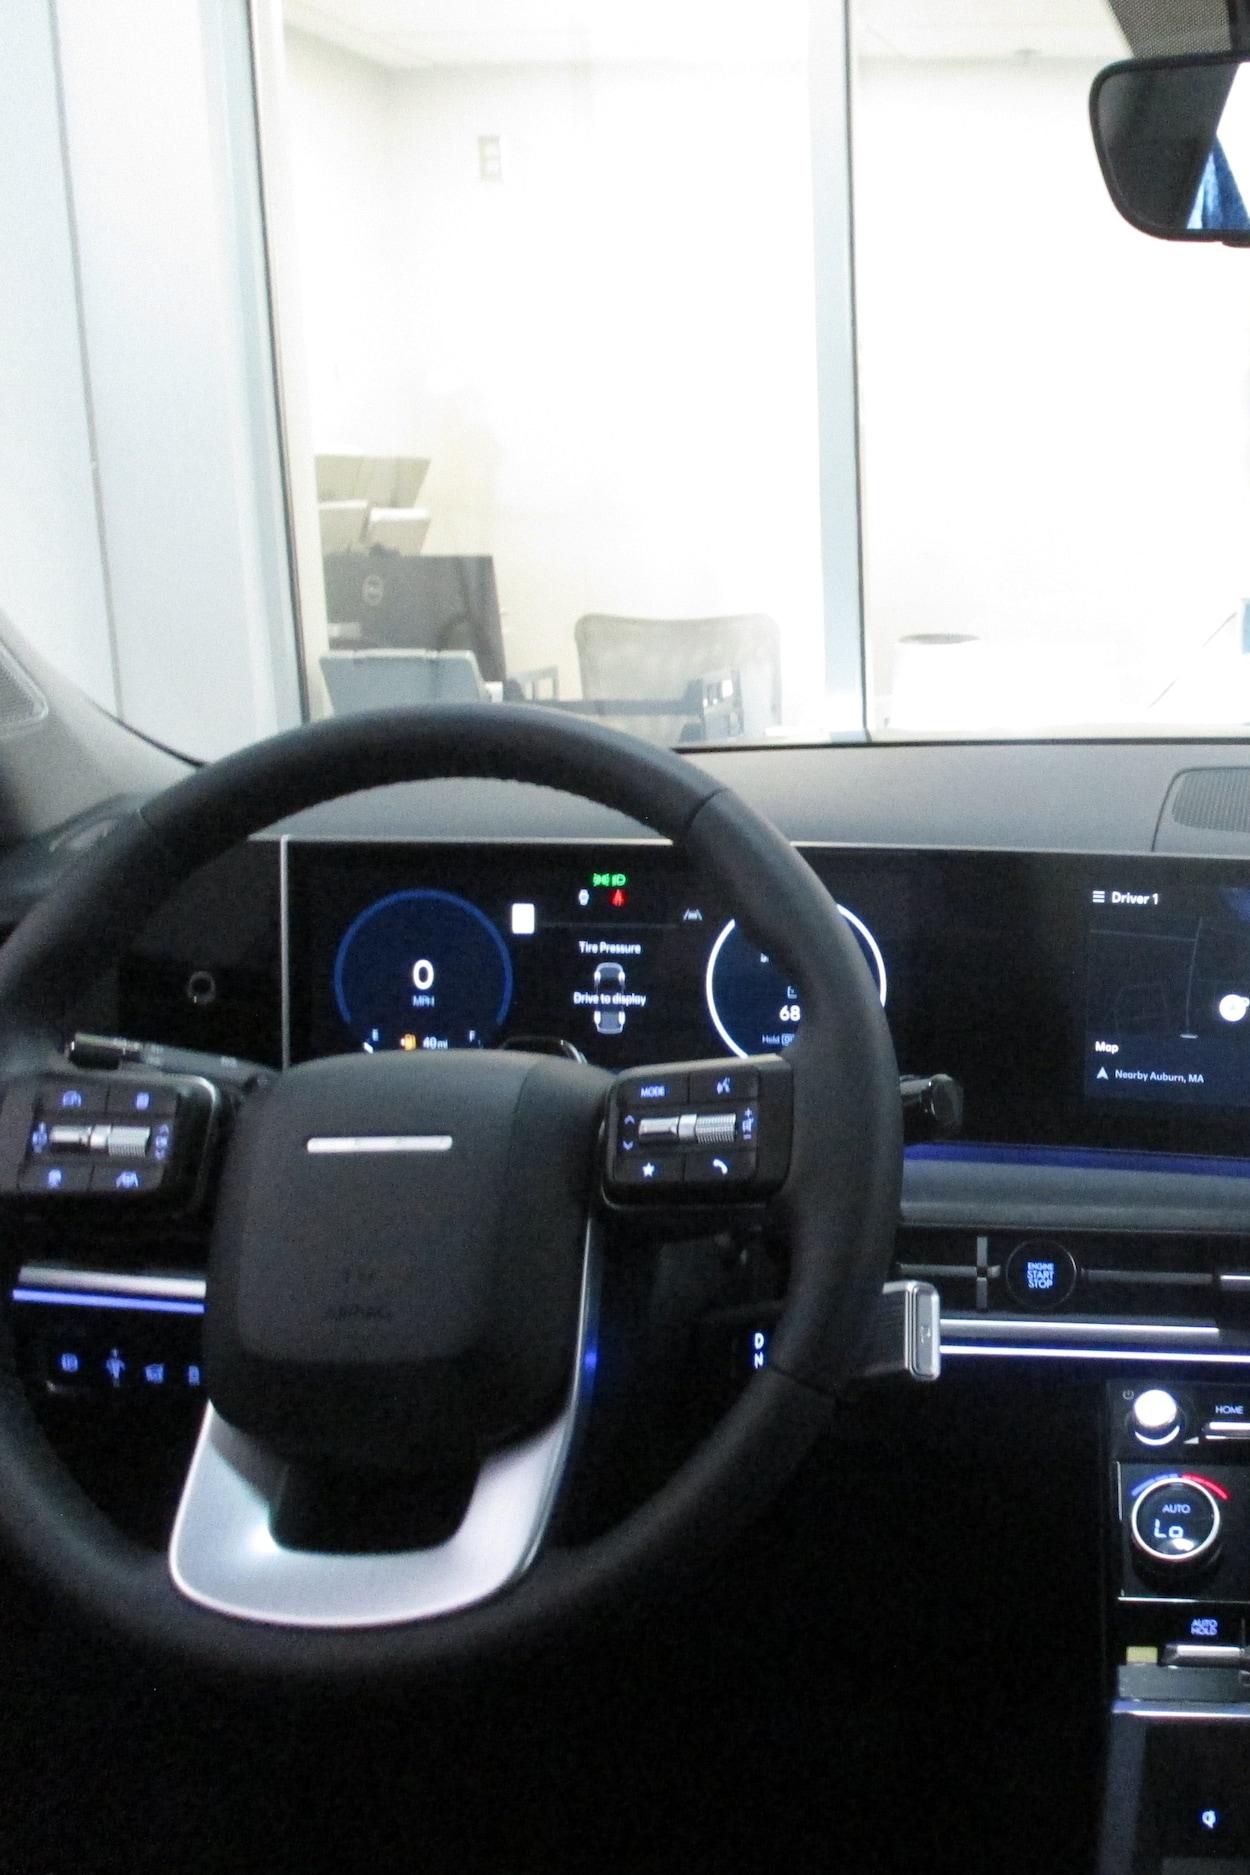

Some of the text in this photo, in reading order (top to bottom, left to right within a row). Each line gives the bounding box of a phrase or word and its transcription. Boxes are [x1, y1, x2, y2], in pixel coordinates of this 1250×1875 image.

[1111, 891, 1160, 905] Driver 1
[579, 940, 642, 955] Tire Pressure
[412, 958, 435, 990] 0
[412, 995, 435, 1007] MPH
[573, 991, 647, 1007] Drive to display
[779, 1004, 801, 1022] 68
[1095, 1041, 1119, 1054] Map
[1115, 1069, 1205, 1084] Nearby Auburn, MA
[640, 1086, 666, 1097] MODE
[1027, 1270, 1055, 1280] START
[1028, 1279, 1054, 1289] STOP
[1215, 1404, 1245, 1415] HOME
[1162, 1504, 1192, 1514] AUTO
[1191, 1618, 1218, 1628] AUTO
[1190, 1626, 1218, 1636] HOLD
